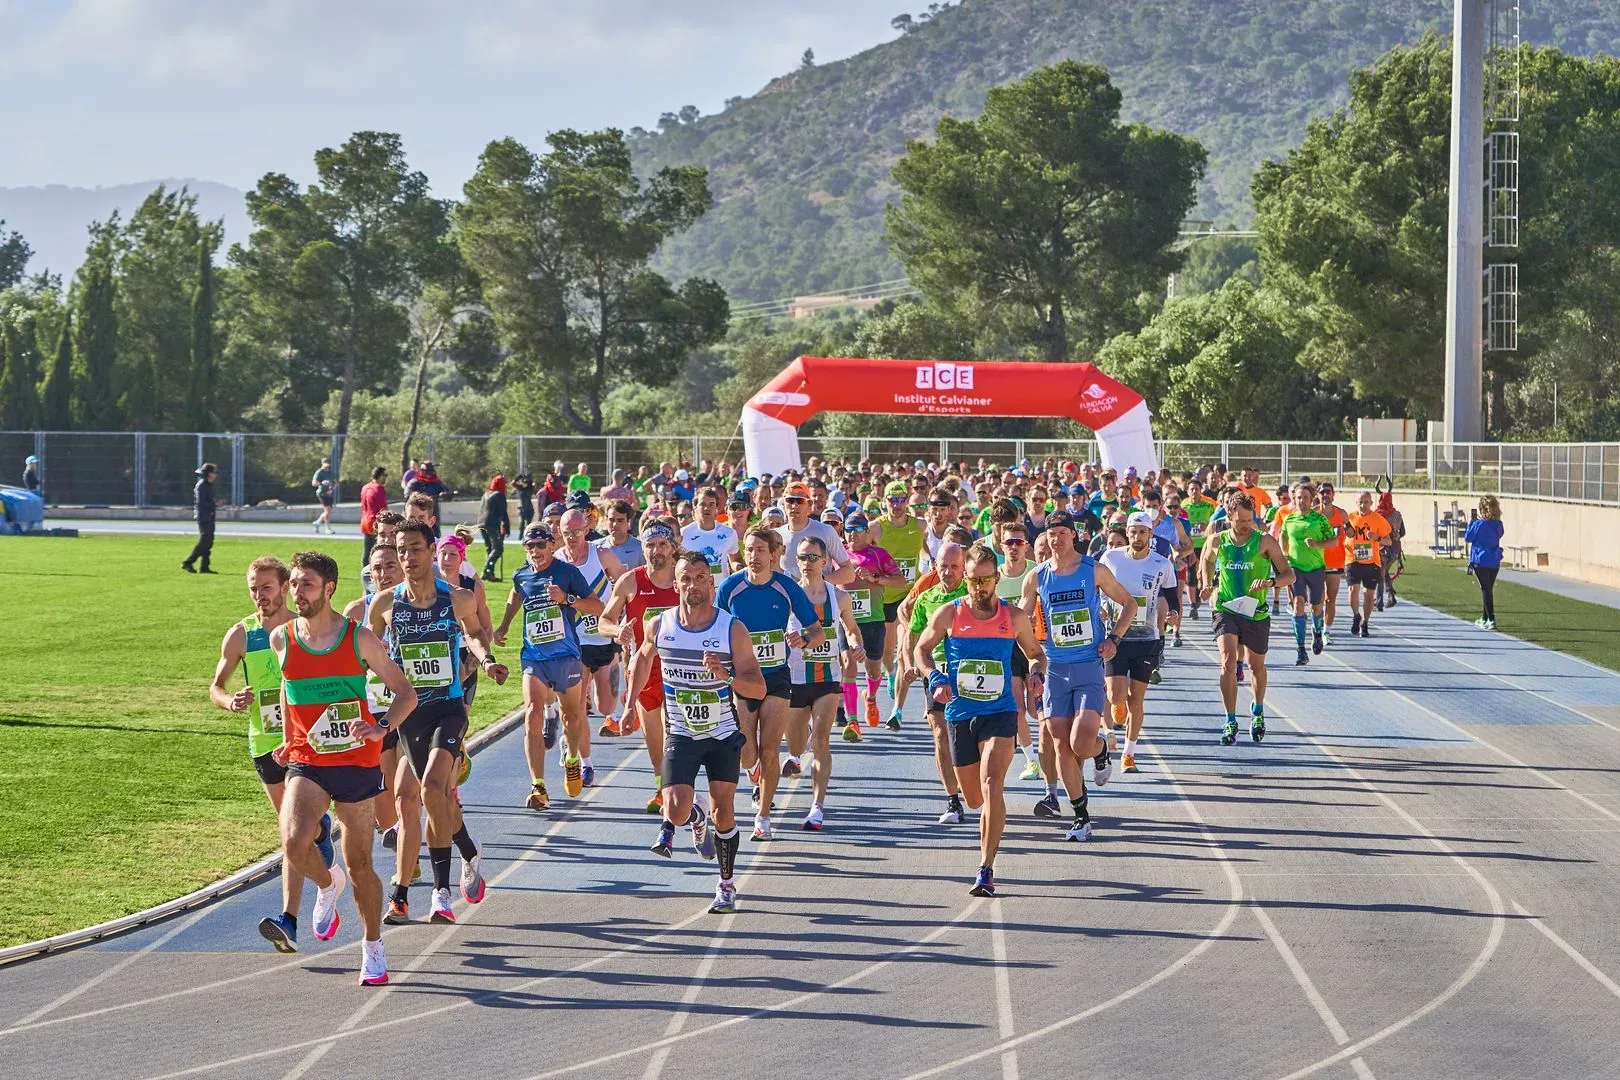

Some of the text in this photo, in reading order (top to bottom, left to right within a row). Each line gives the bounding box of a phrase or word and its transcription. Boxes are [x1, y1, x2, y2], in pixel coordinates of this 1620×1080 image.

[920, 370, 970, 384] ICE
[894, 394, 993, 406] Institut Calvianer
[918, 405, 971, 413] d'Esports
[1051, 590, 1083, 602] PETERS
[536, 620, 554, 634] 267
[1061, 624, 1083, 637] 464
[758, 644, 775, 657] 211
[413, 660, 440, 675] 506
[976, 676, 984, 689] 2
[685, 705, 709, 720] 248
